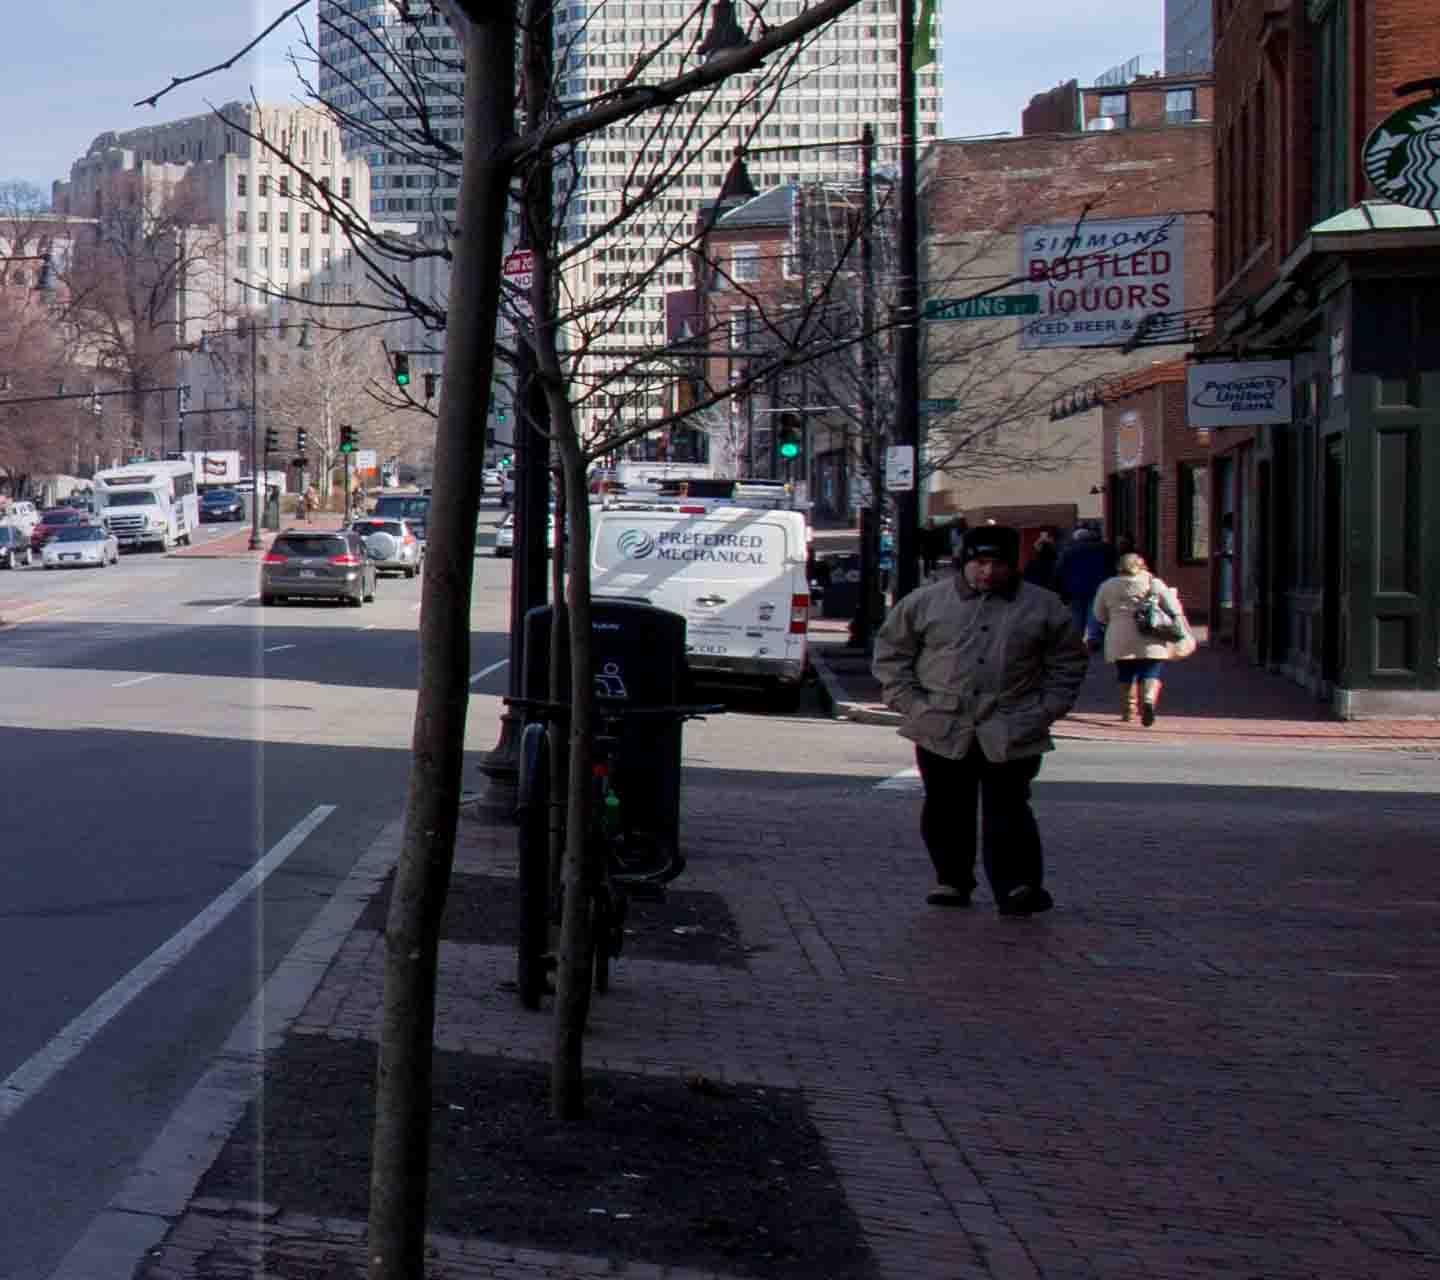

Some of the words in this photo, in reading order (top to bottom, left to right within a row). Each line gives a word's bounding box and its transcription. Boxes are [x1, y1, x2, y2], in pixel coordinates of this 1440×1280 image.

[1033, 228, 1169, 252] SIMMONS
[1030, 251, 1171, 283] BOTTLED
[935, 297, 1008, 318] IRVING
[1040, 283, 1170, 315] IQUORS
[1073, 319, 1116, 333] BEER
[1216, 391, 1274, 402] United
[1232, 401, 1273, 412] Bank
[658, 531, 763, 548] PREFERRED
[656, 547, 768, 565] MECHANICAL
